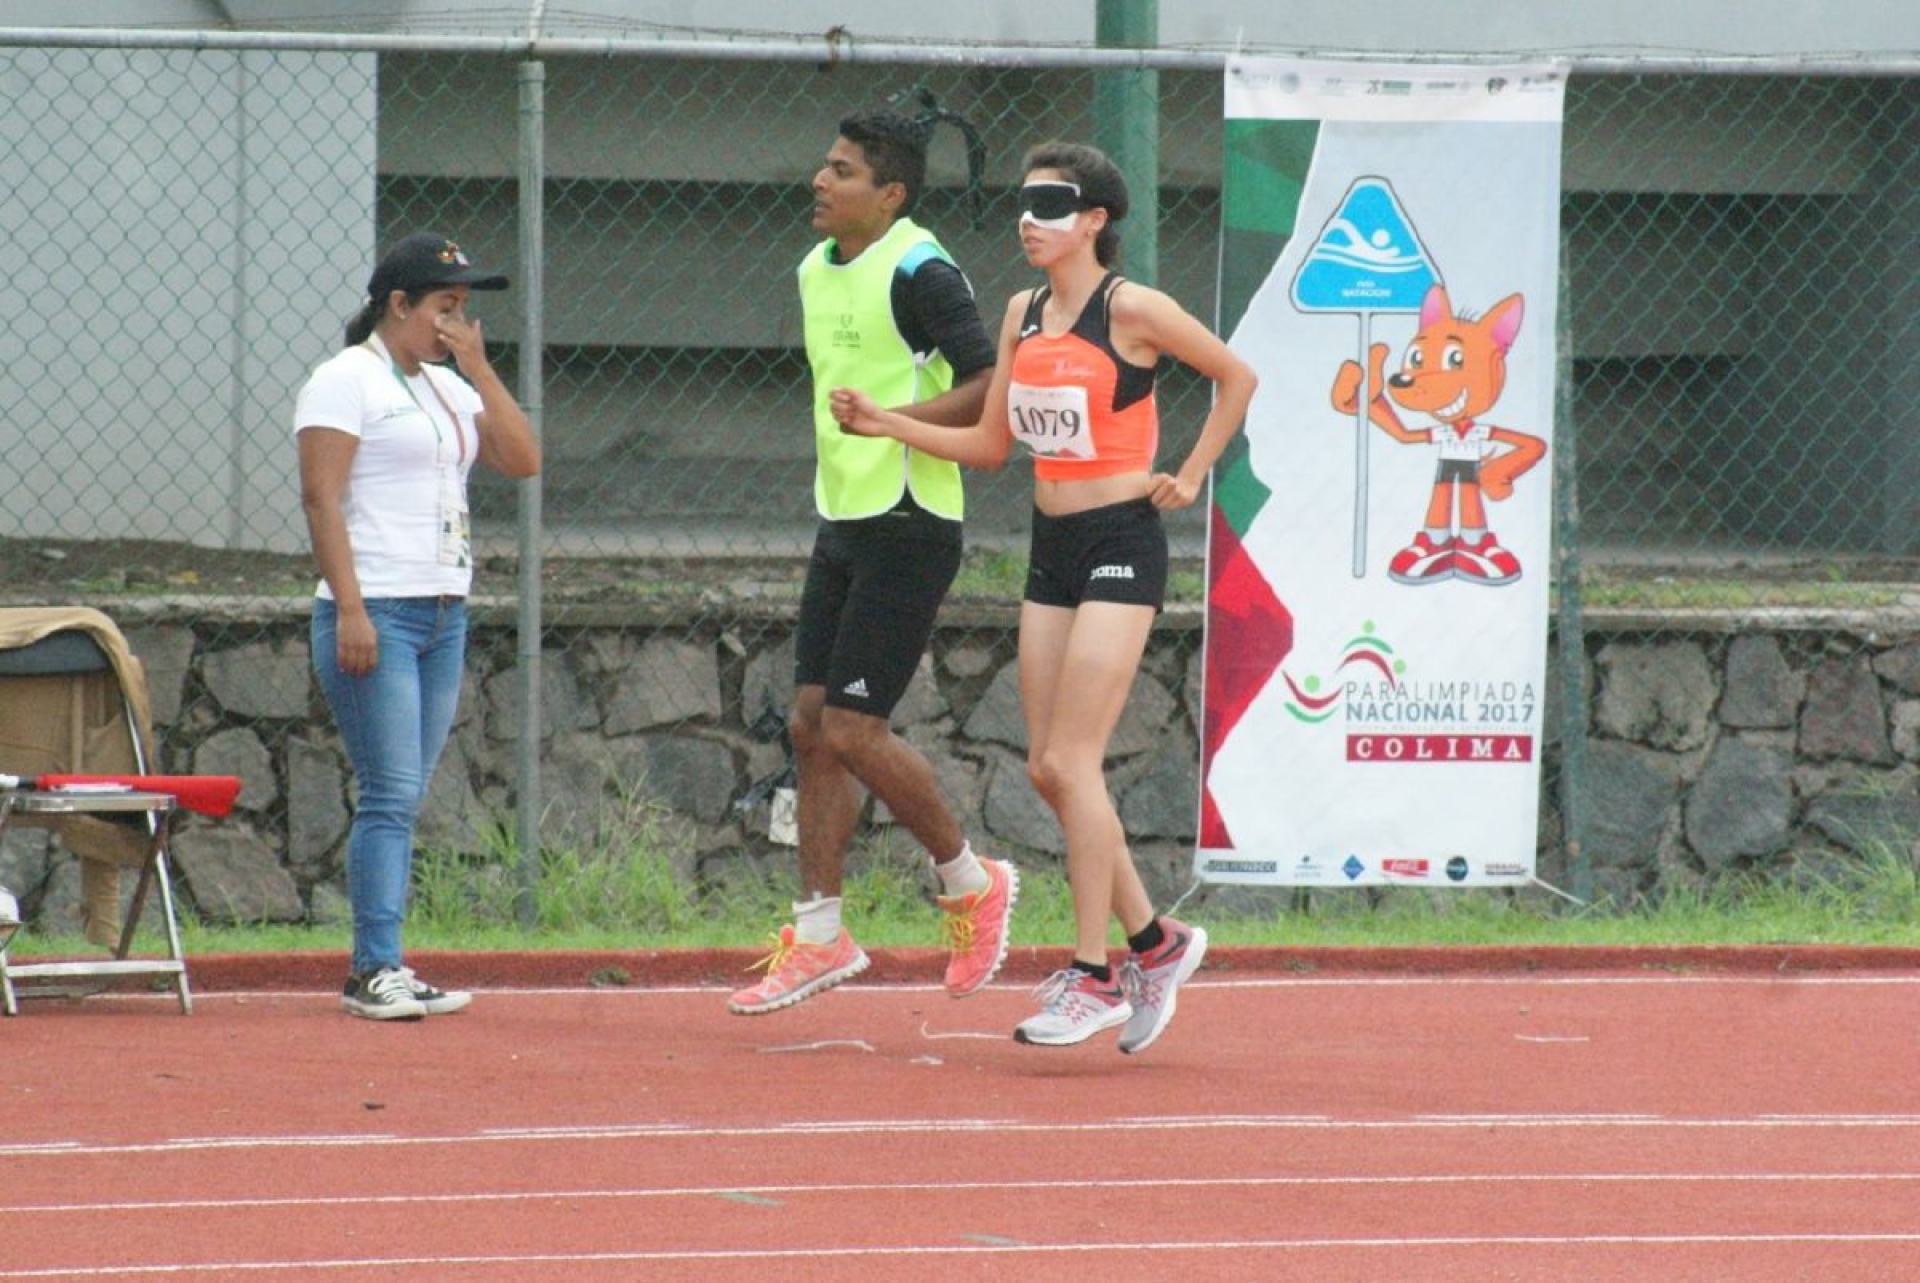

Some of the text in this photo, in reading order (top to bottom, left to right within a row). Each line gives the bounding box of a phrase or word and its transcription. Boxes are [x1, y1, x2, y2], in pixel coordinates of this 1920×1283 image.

[1013, 404, 1081, 438] 1079
[1346, 681, 1535, 701] PARALIMPIADA
[1346, 703, 1534, 723] NACIONAL 2017
[1356, 737, 1523, 759] COLIMA
